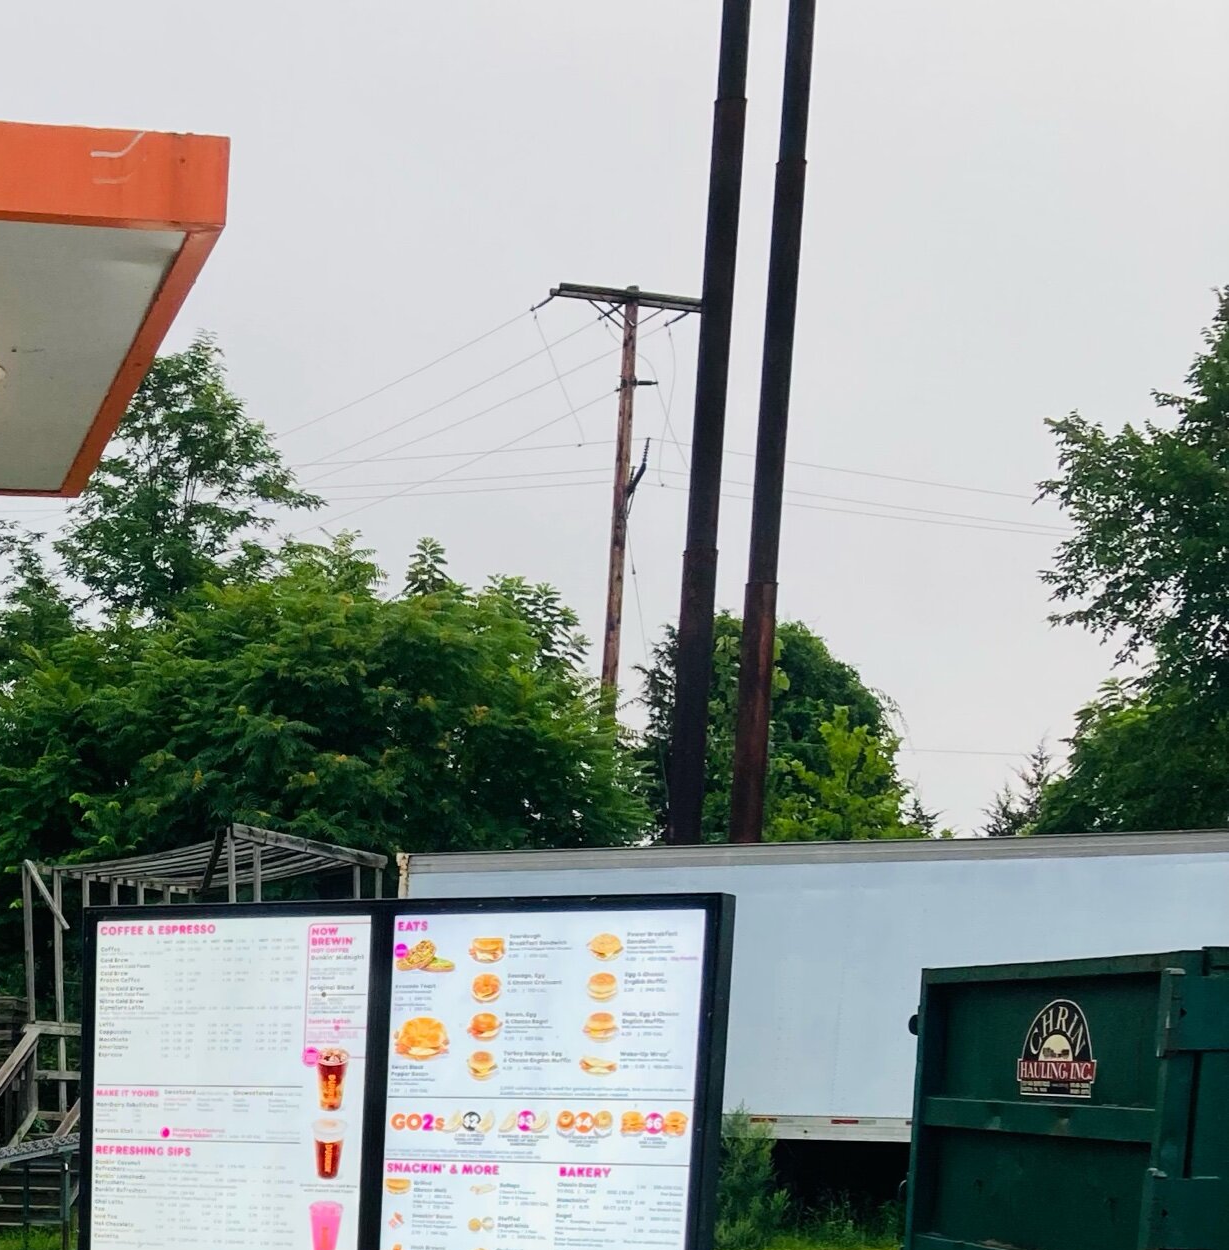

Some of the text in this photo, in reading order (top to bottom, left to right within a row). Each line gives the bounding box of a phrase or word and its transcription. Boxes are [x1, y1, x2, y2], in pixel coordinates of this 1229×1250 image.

[100, 924, 216, 936] COFFEE & ESPRESSO
[311, 927, 338, 935] NOW
[397, 921, 428, 931] EATS
[1029, 1006, 1087, 1058] CHRIN
[1070, 1062, 1093, 1080] INC.
[390, 1113, 445, 1131] GO2s
[518, 1114, 533, 1127] $3
[574, 1117, 591, 1129] $4
[646, 1117, 663, 1129] $6
[95, 1145, 191, 1157] REFRESHING SIPS
[386, 1163, 500, 1175] SNACKIN' & MORE
[559, 1167, 611, 1178] BAKERY
